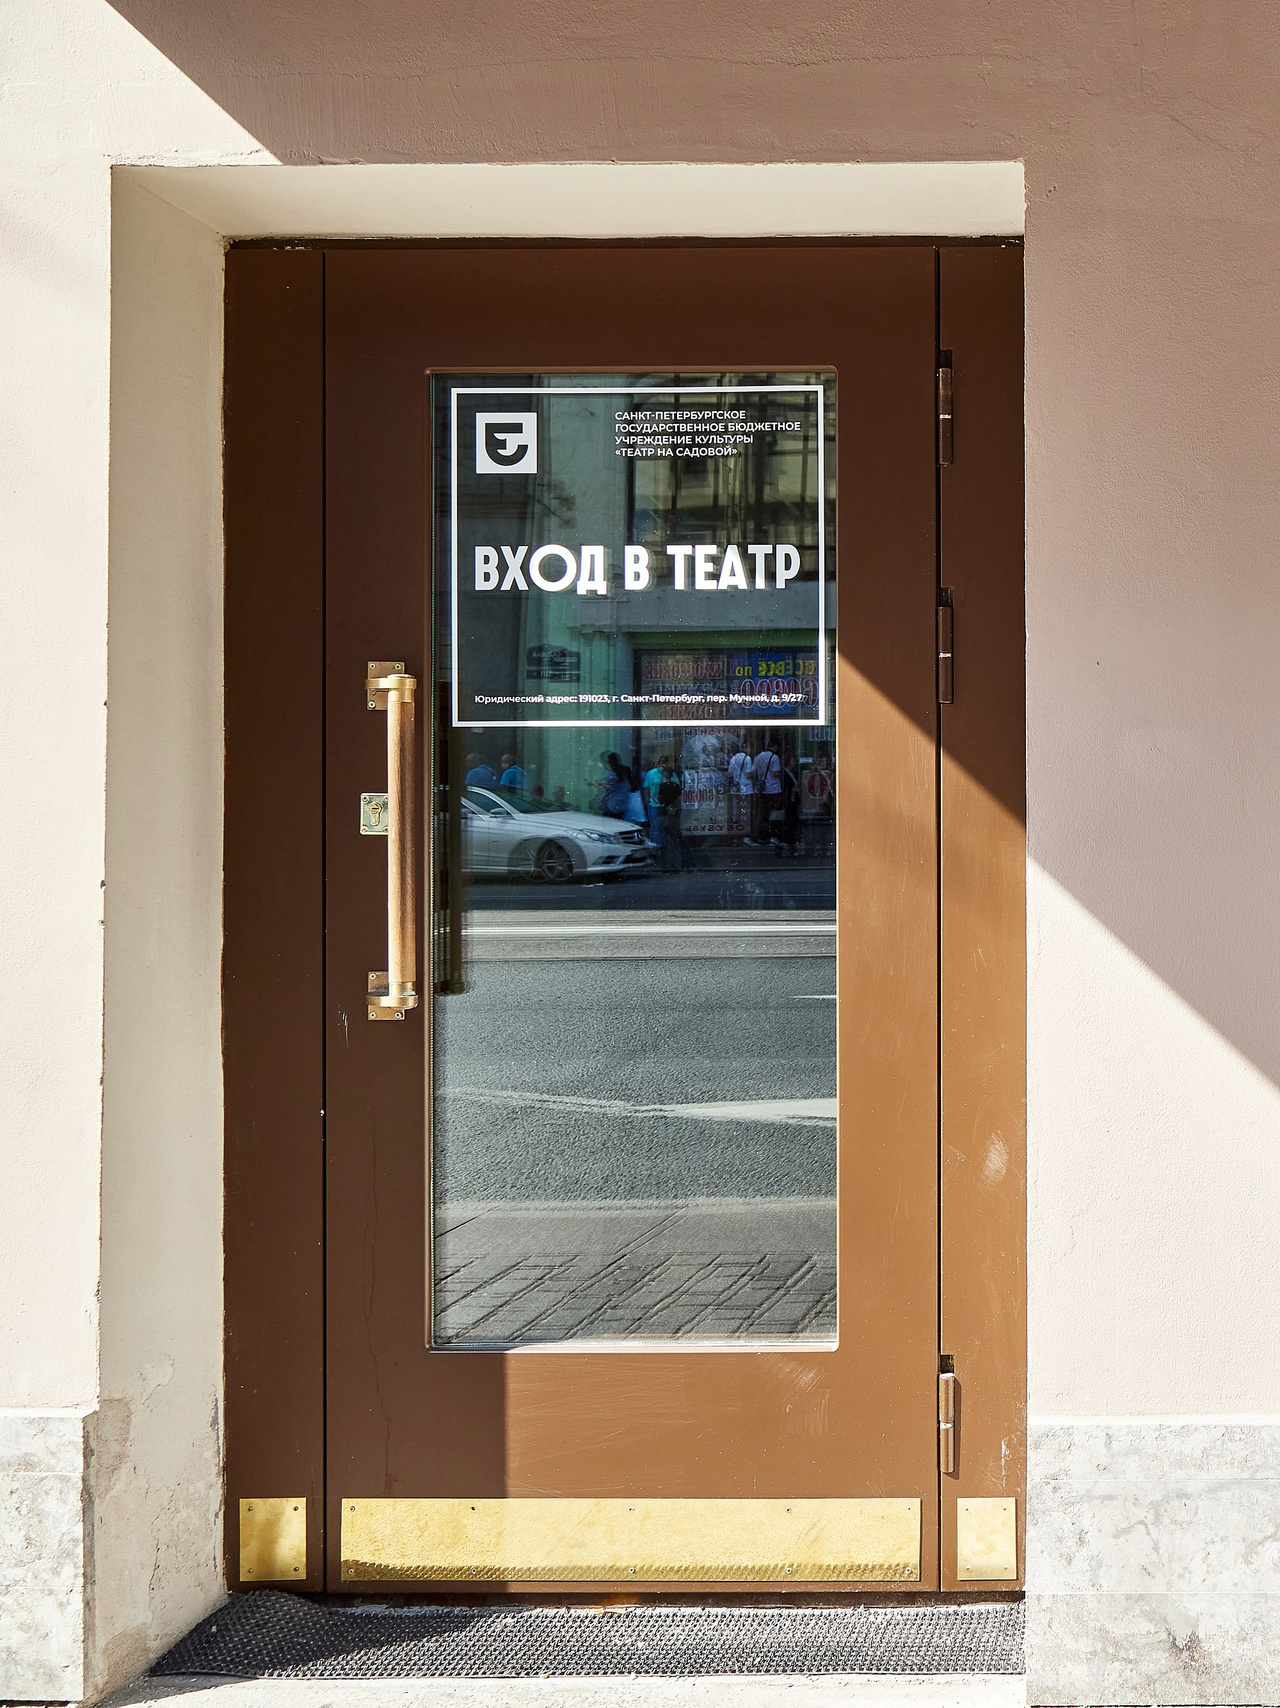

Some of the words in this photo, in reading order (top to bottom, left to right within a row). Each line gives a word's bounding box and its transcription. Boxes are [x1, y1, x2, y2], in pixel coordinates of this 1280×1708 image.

[615, 410, 746, 421] САНКТ-ПЕТЕРБУРГСКОЕ
[615, 422, 725, 433] ГОСУДАРСТВЕННОЕ
[728, 421, 801, 432] БЮДЖЕТНОЕ
[615, 435, 692, 445] УЧРЕЖДЕНИЕ
[695, 434, 753, 444] КУЛЬТУРЫ
[615, 447, 655, 457] «ТЕАТР
[657, 447, 673, 457] НА
[676, 445, 737, 458] САДОВОЙ»
[474, 544, 607, 595] ВХОД
[624, 545, 650, 590] В
[666, 544, 801, 590] ТЕАТР
[474, 694, 544, 704] Юридический
[546, 695, 577, 704] адрес:
[579, 694, 611, 704] 191023,
[621, 693, 704, 703] Санкт-Петербург,
[707, 695, 727, 703] пер.
[729, 693, 769, 703] Мучной,
[771, 695, 780, 703] д.
[781, 693, 803, 703] 9/27
